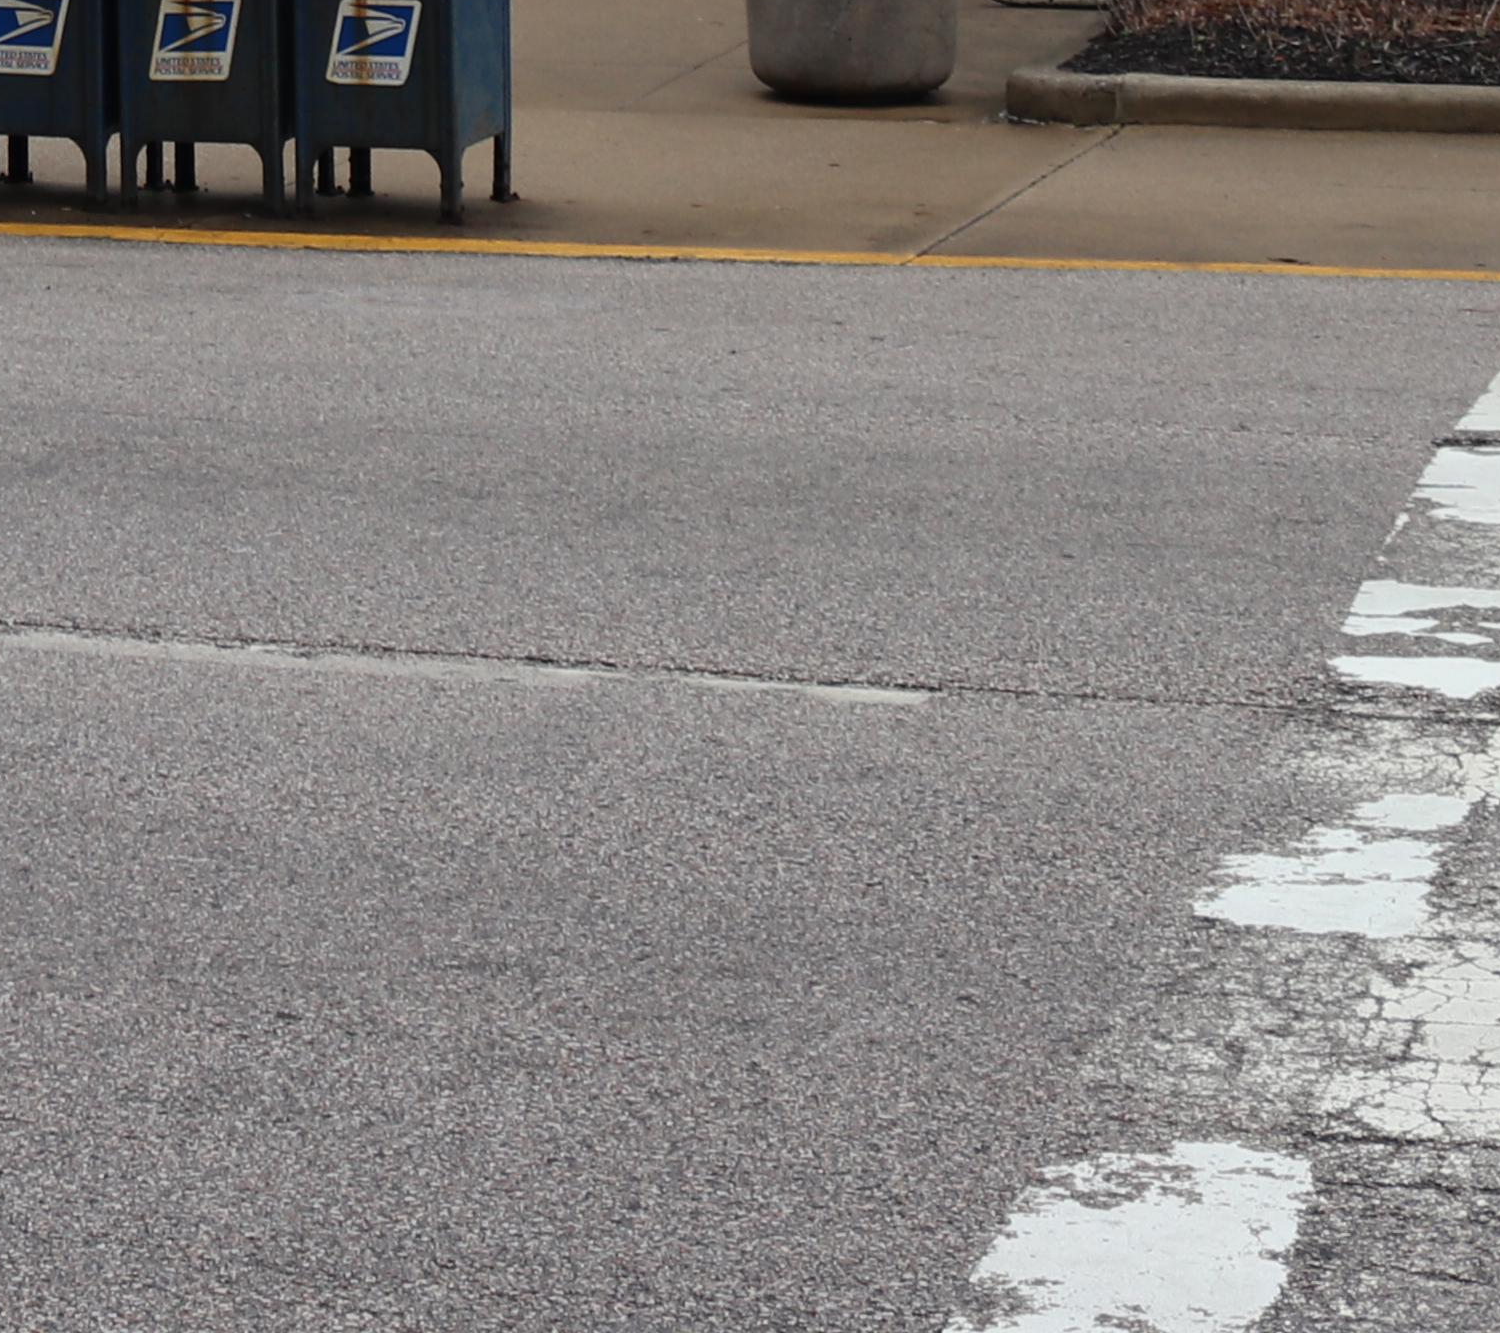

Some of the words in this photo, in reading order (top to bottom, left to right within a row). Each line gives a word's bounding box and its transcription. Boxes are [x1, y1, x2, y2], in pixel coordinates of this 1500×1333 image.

[18, 51, 47, 60] STATES
[16, 61, 48, 69] SERVICE
[156, 57, 189, 65] UNITED
[190, 57, 221, 65] STATES
[368, 62, 399, 70] STATES
[154, 67, 185, 75] POSTAL
[189, 67, 222, 75] SERVICE
[331, 71, 363, 79] POSTAL
[366, 72, 401, 80] SERVICE
